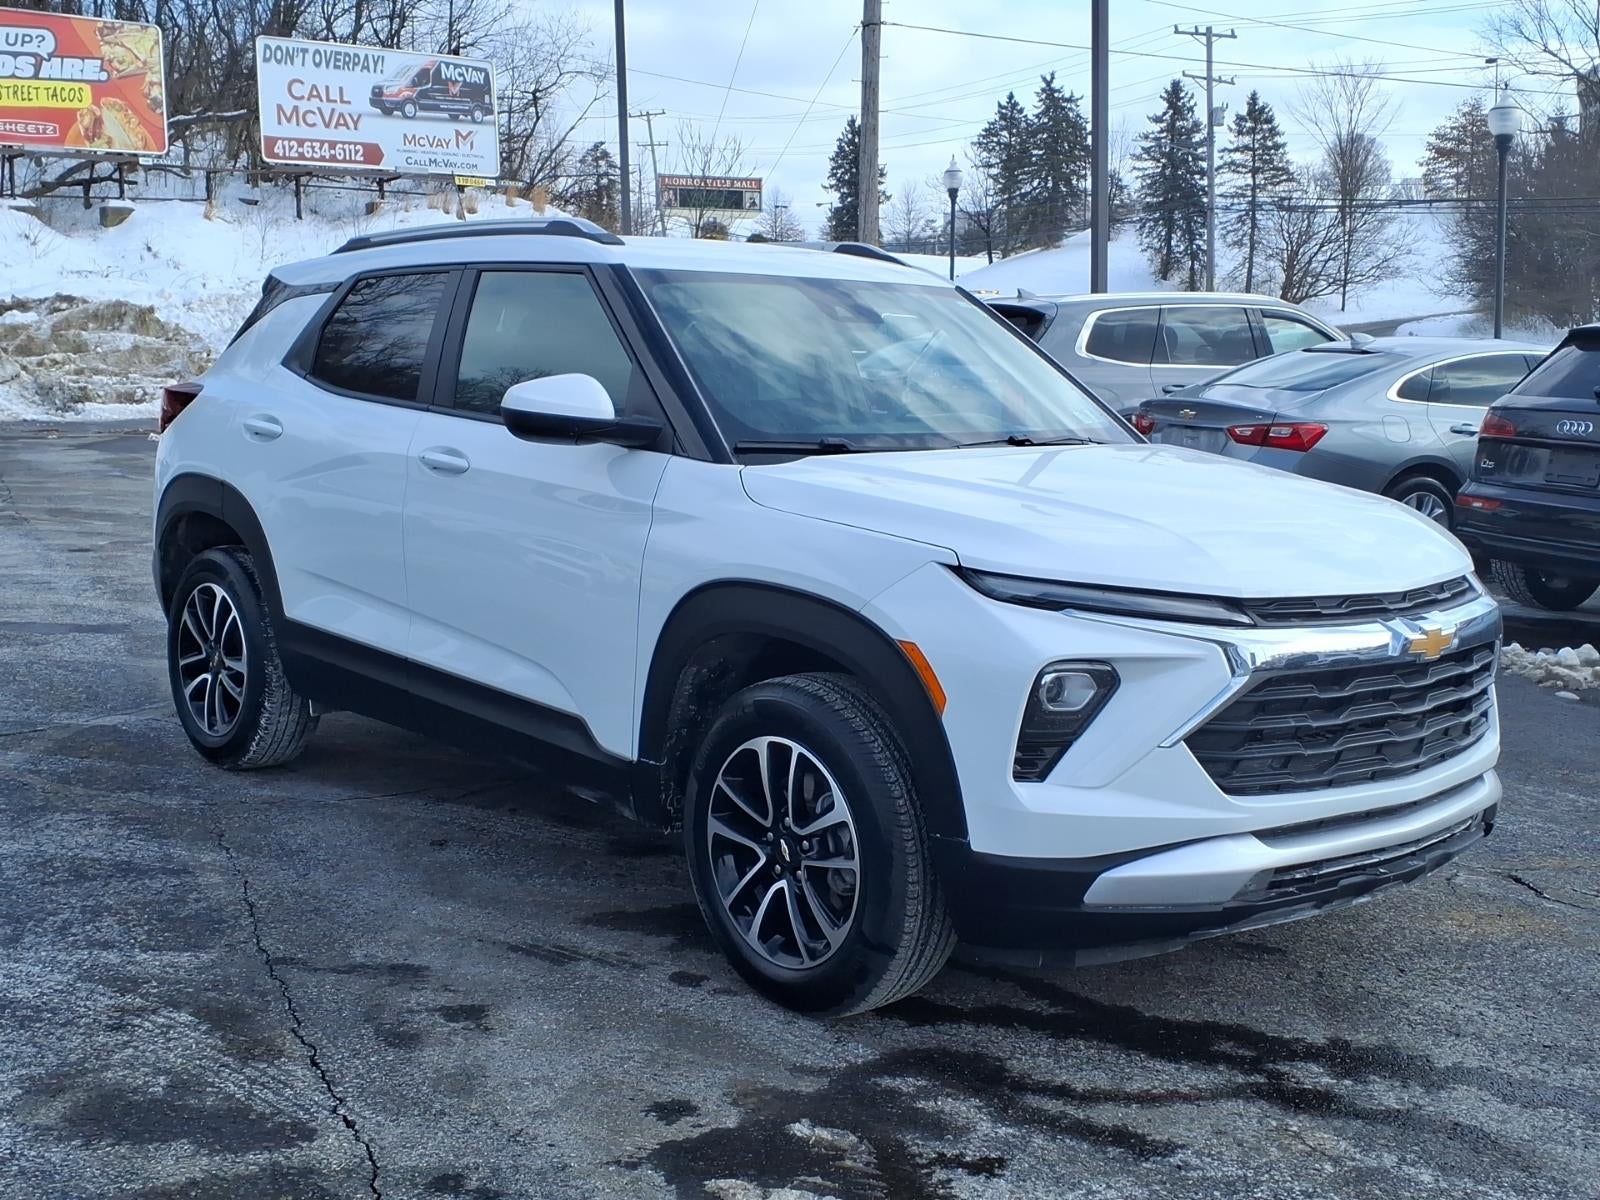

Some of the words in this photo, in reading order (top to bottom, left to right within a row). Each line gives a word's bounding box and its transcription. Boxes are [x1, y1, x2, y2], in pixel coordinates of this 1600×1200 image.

[5, 31, 46, 48] UP?
[38, 57, 109, 81] ARE.
[262, 43, 309, 67] DON'T
[312, 48, 385, 74] OVERPAY!
[43, 86, 84, 103] TACOS
[287, 78, 351, 105] CALL
[274, 139, 364, 161] 412-634-6112
[733, 180, 758, 188] MALL
